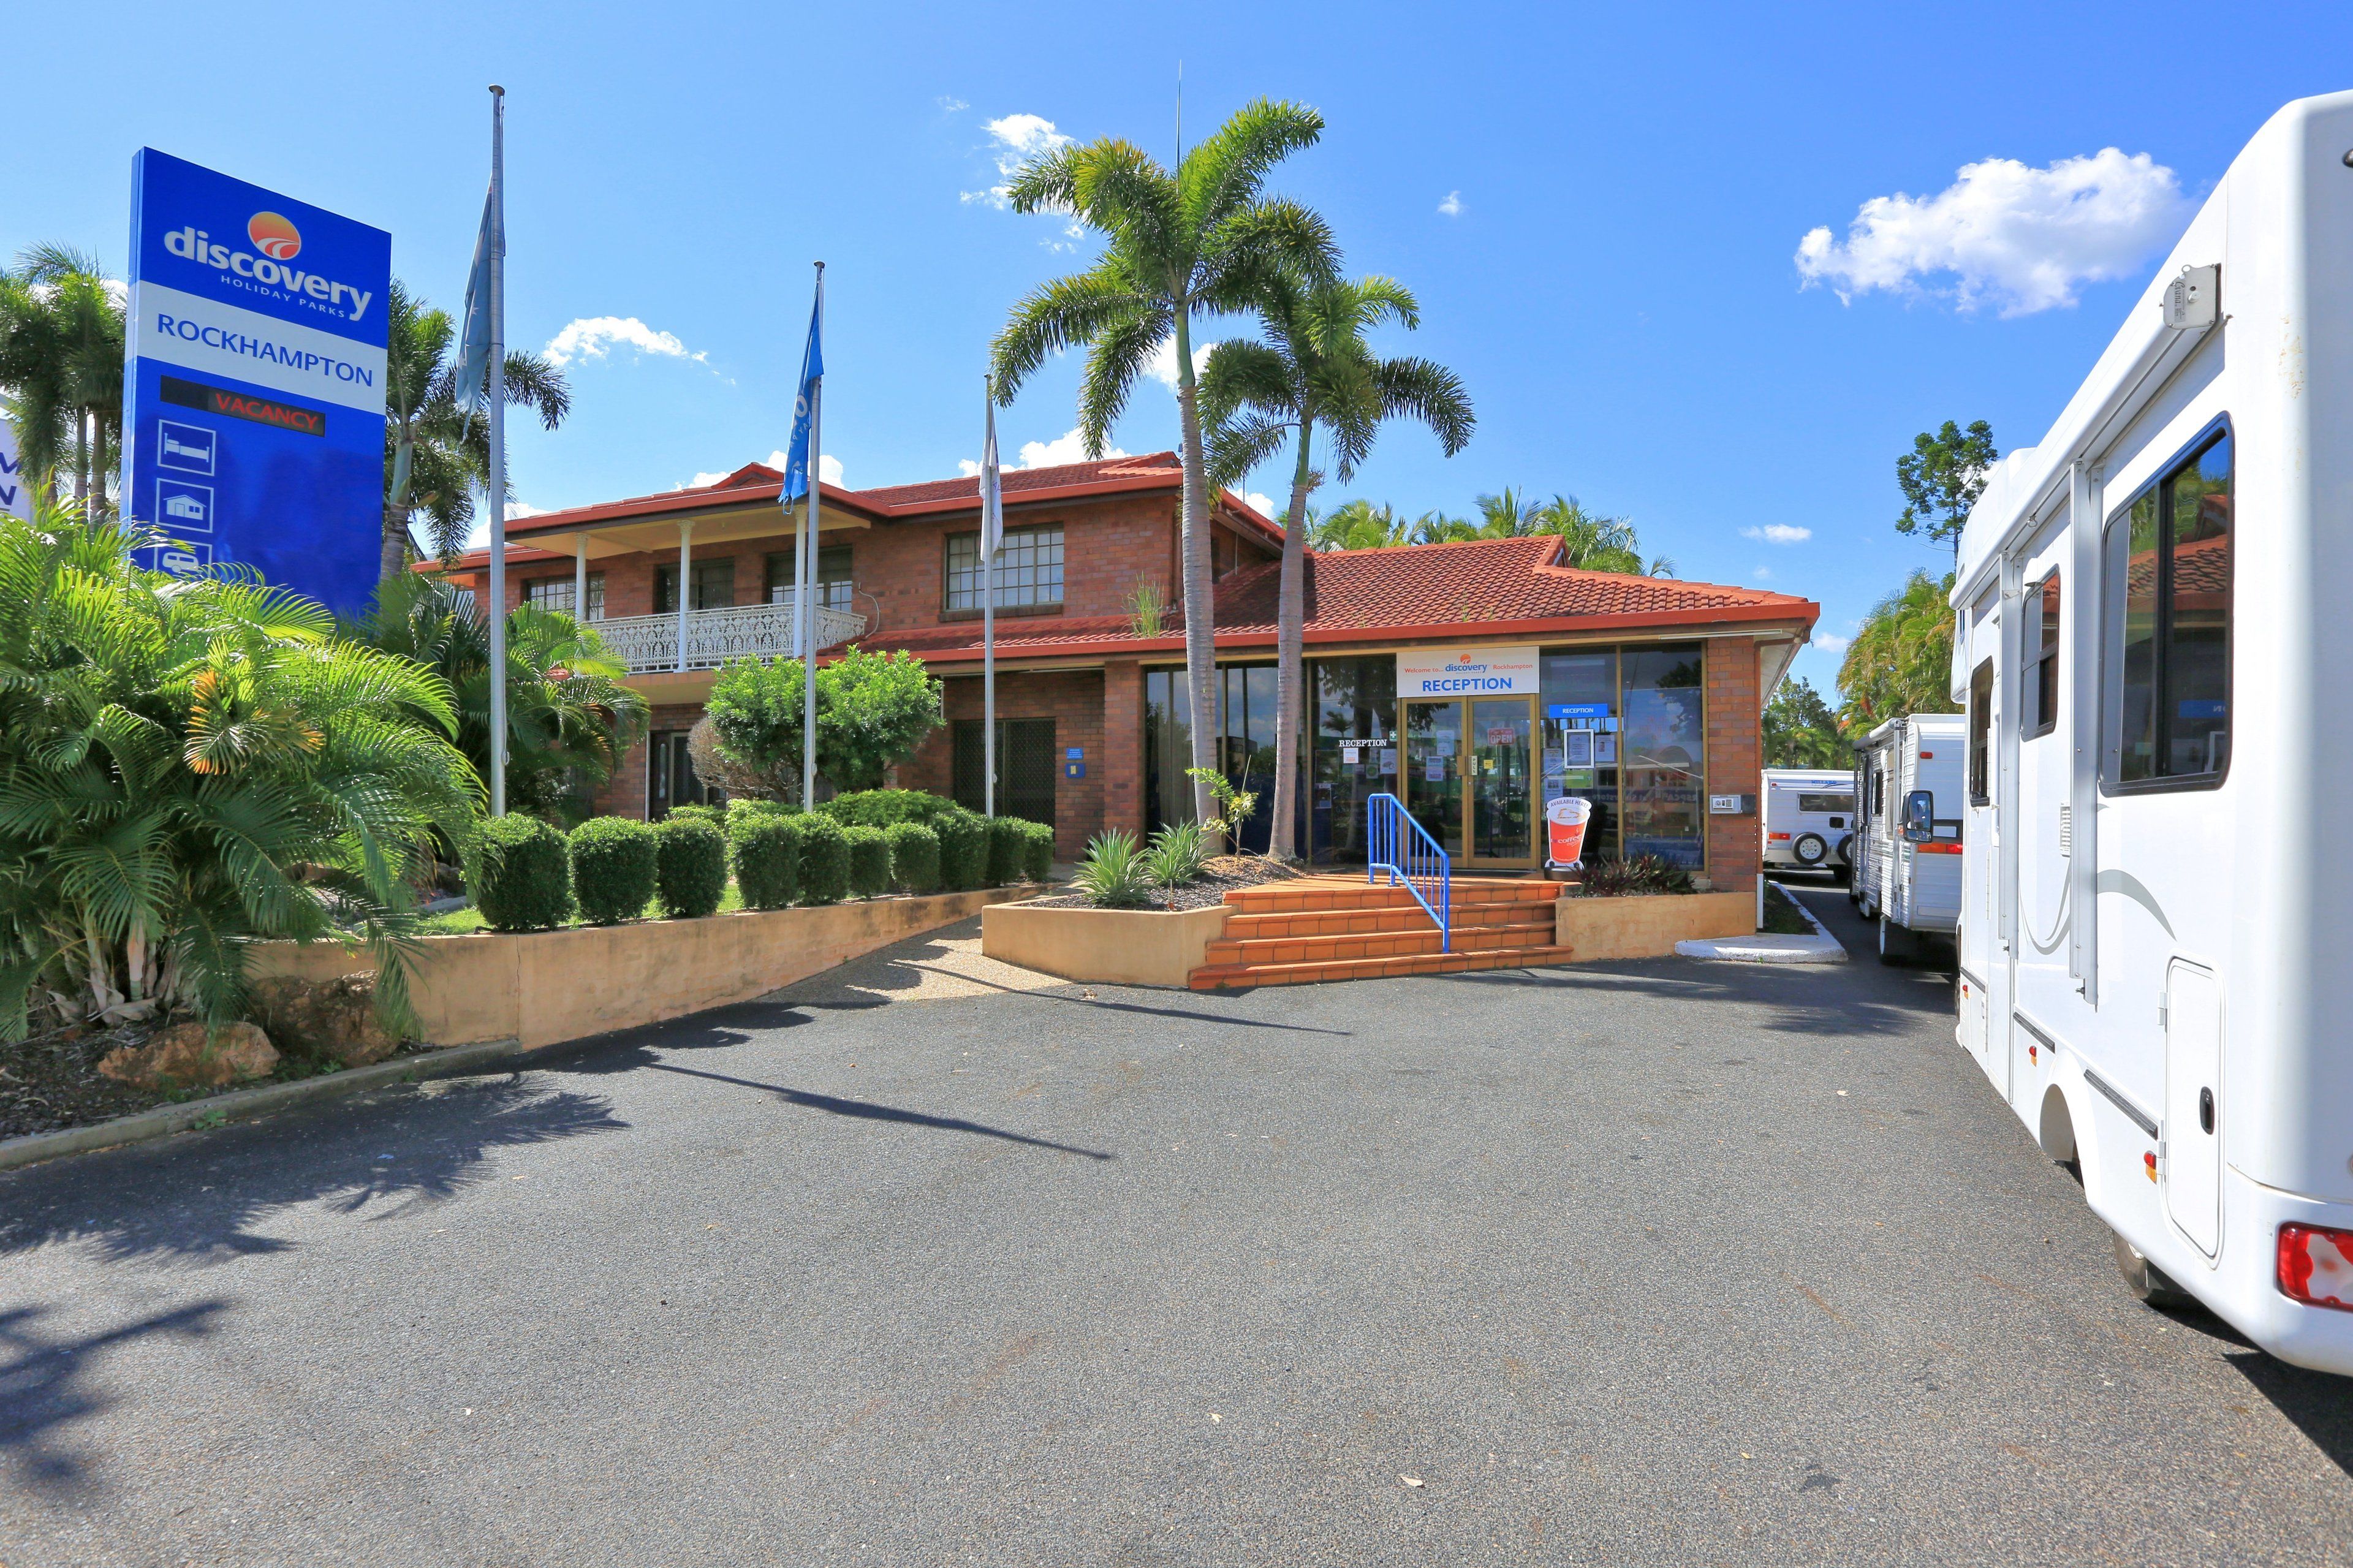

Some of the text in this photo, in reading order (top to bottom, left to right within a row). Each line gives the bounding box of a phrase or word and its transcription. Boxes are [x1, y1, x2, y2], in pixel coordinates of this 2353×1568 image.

[164, 225, 373, 322] discovery
[221, 275, 345, 318] HOLIDAY PARKS
[157, 313, 373, 387] ROCKHAMPTON
[215, 393, 319, 430] VACANCY
[1445, 664, 1488, 673] discovery
[1422, 677, 1512, 692] RECEPTION
[1338, 739, 1387, 748] RECEPTION
[1490, 735, 1512, 744] OPEN
[1550, 799, 1589, 809] AVAILABLE HERE!
